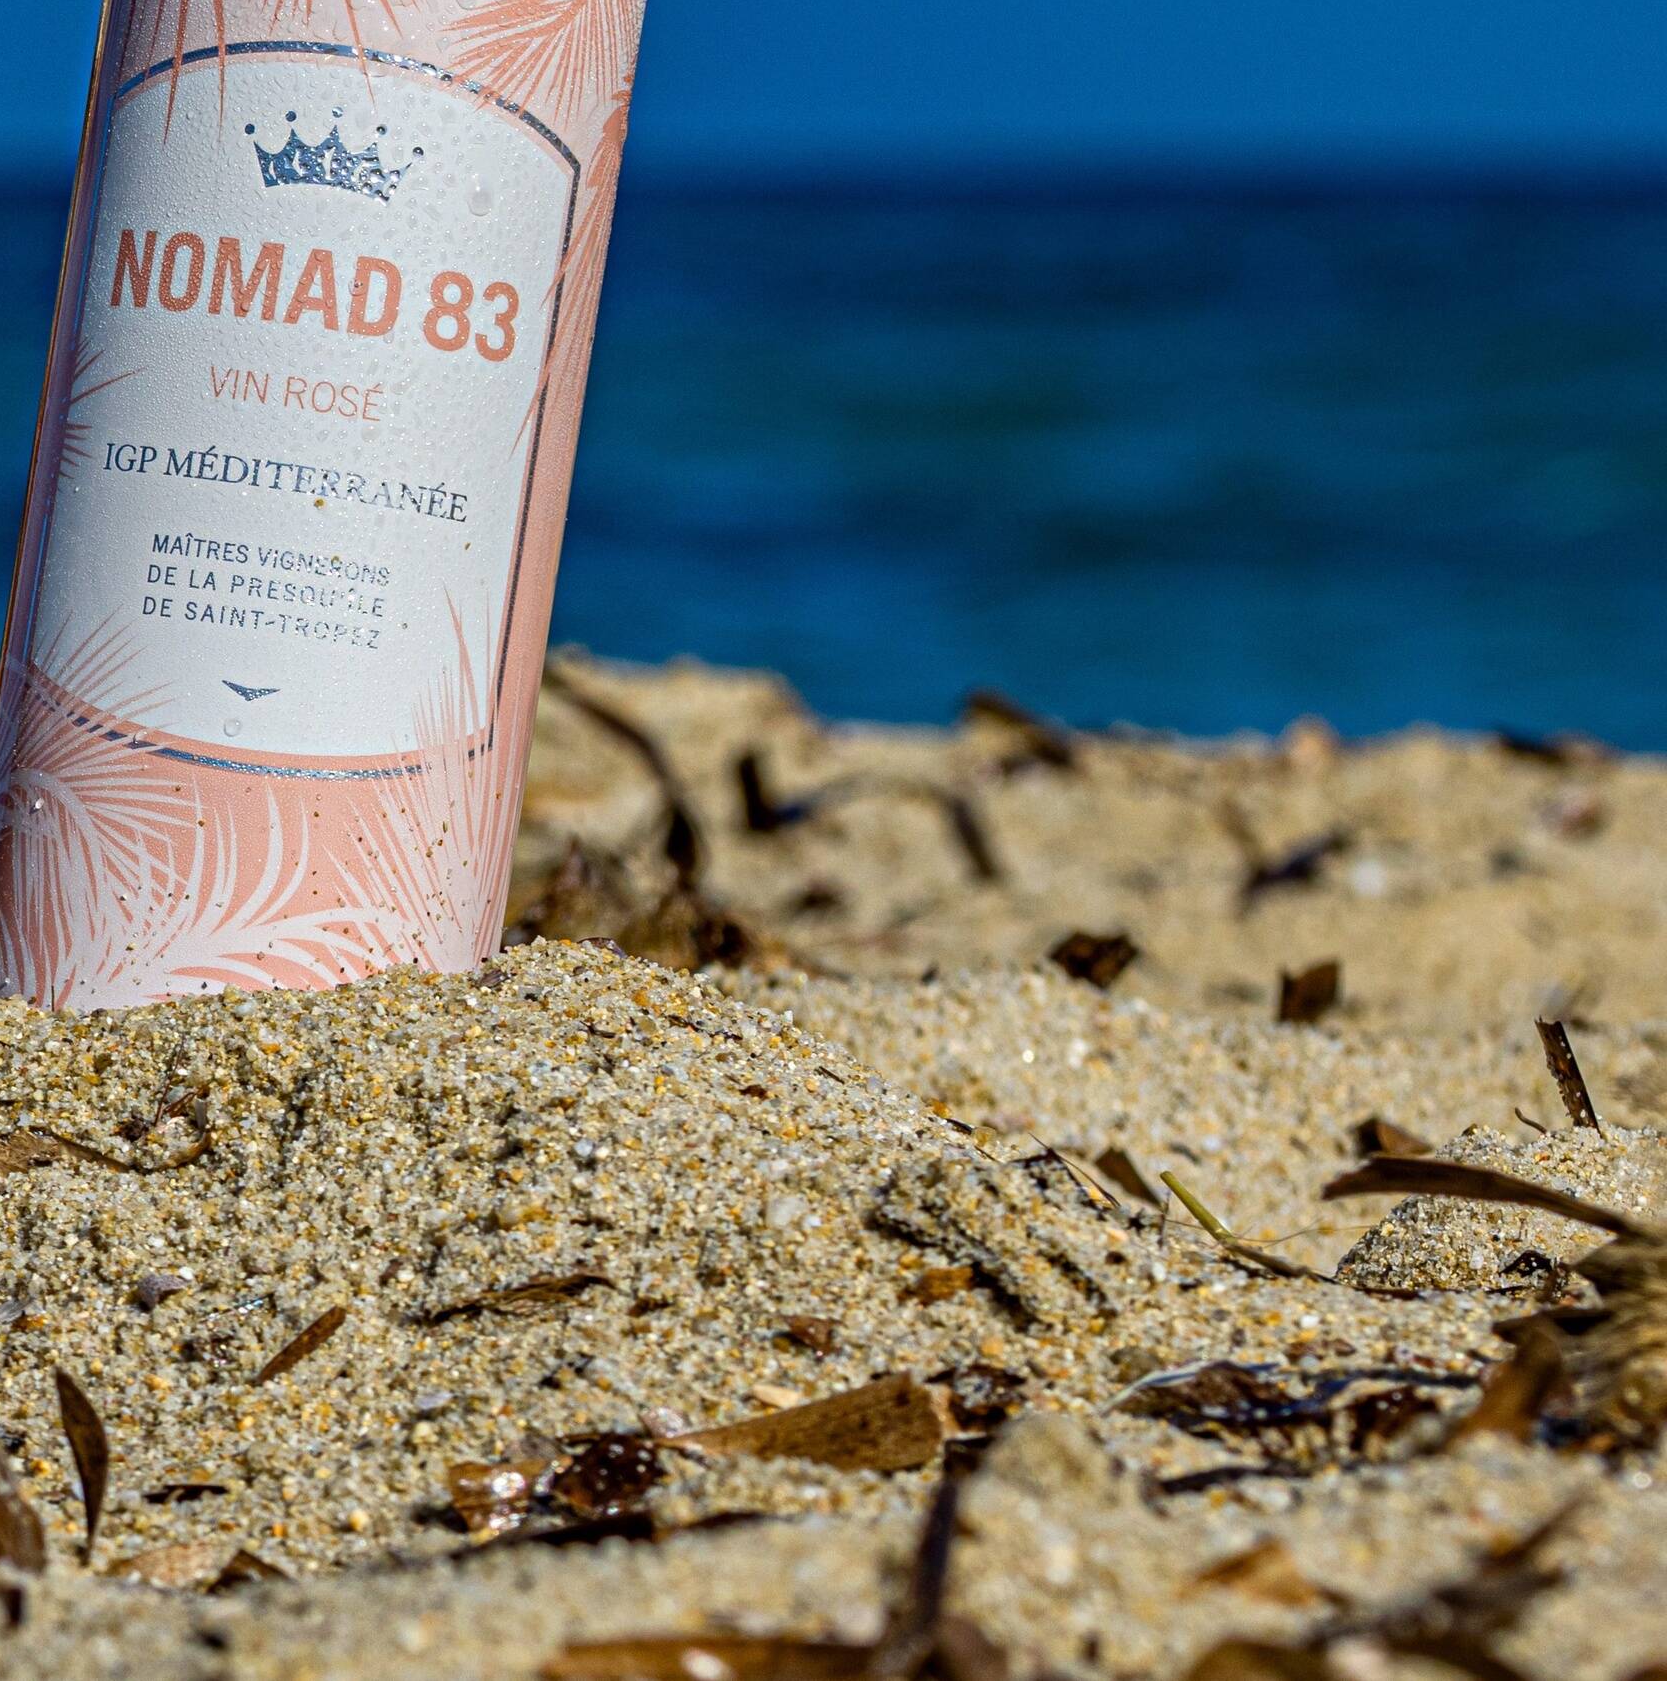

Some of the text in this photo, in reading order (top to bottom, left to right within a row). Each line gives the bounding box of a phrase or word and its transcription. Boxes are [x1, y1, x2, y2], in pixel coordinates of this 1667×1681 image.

[110, 229, 520, 362] NOMAD 83
[210, 366, 385, 421] VIN ROSÉ
[103, 443, 468, 522] IGP MÉDITERRANÉE
[147, 564, 177, 586] DE
[189, 569, 216, 590] LA
[152, 533, 391, 586] MAÎTRES VIGNERONS
[142, 596, 381, 649] DE SAINT-TROPEZ
